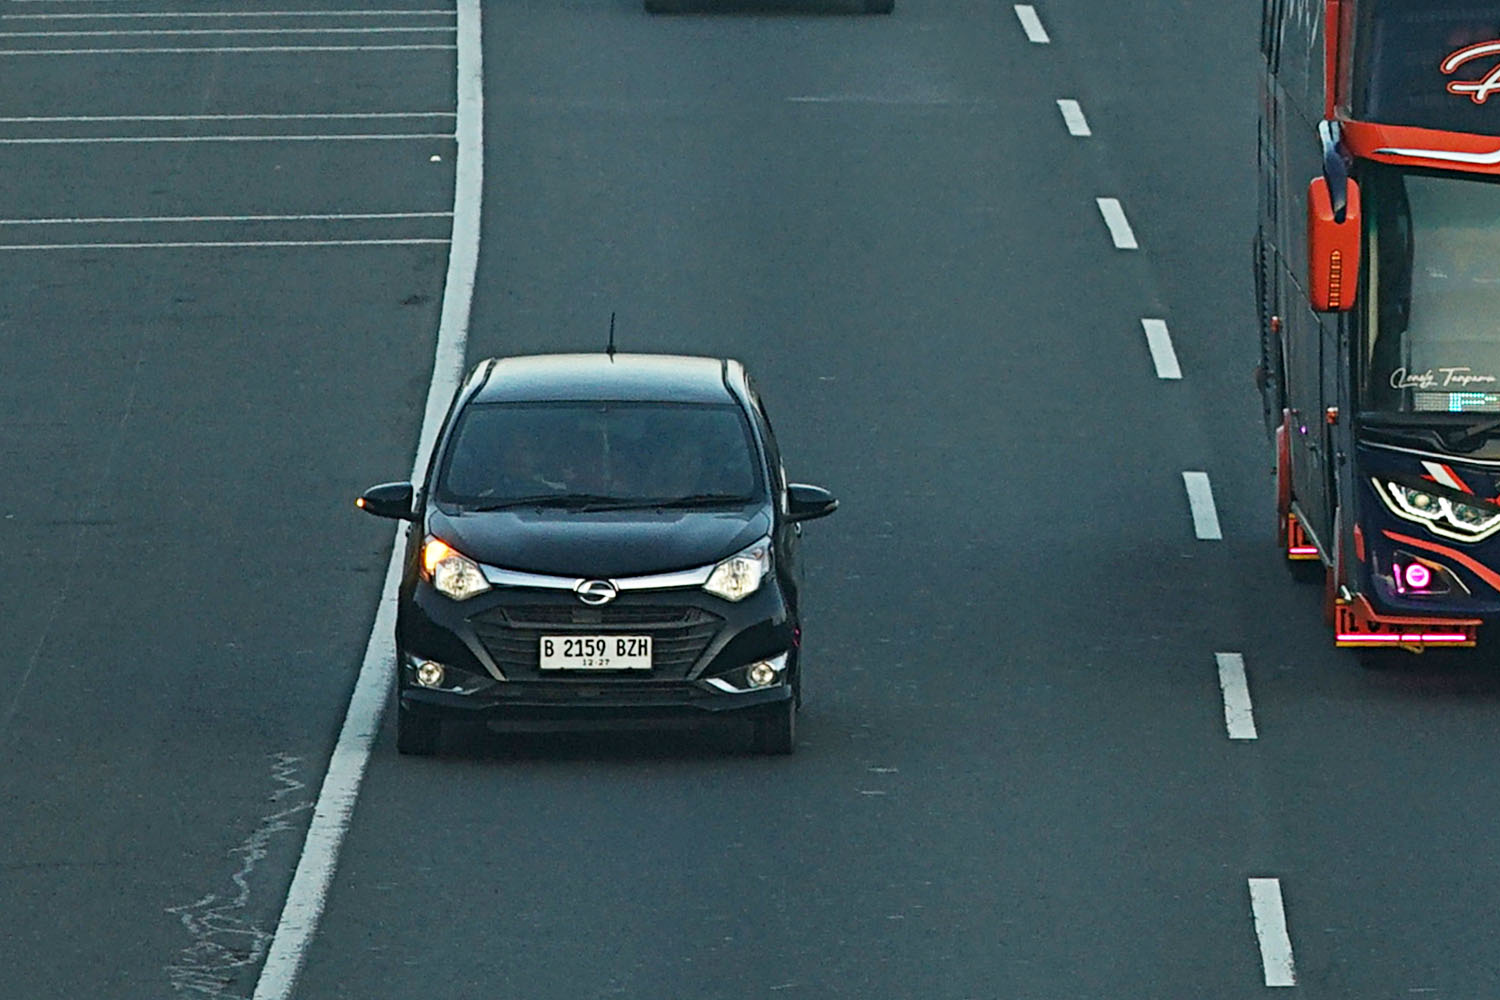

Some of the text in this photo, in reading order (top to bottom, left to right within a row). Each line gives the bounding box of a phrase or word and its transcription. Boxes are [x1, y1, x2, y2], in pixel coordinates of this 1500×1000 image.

[544, 639, 648, 657] B 2159 BZH
